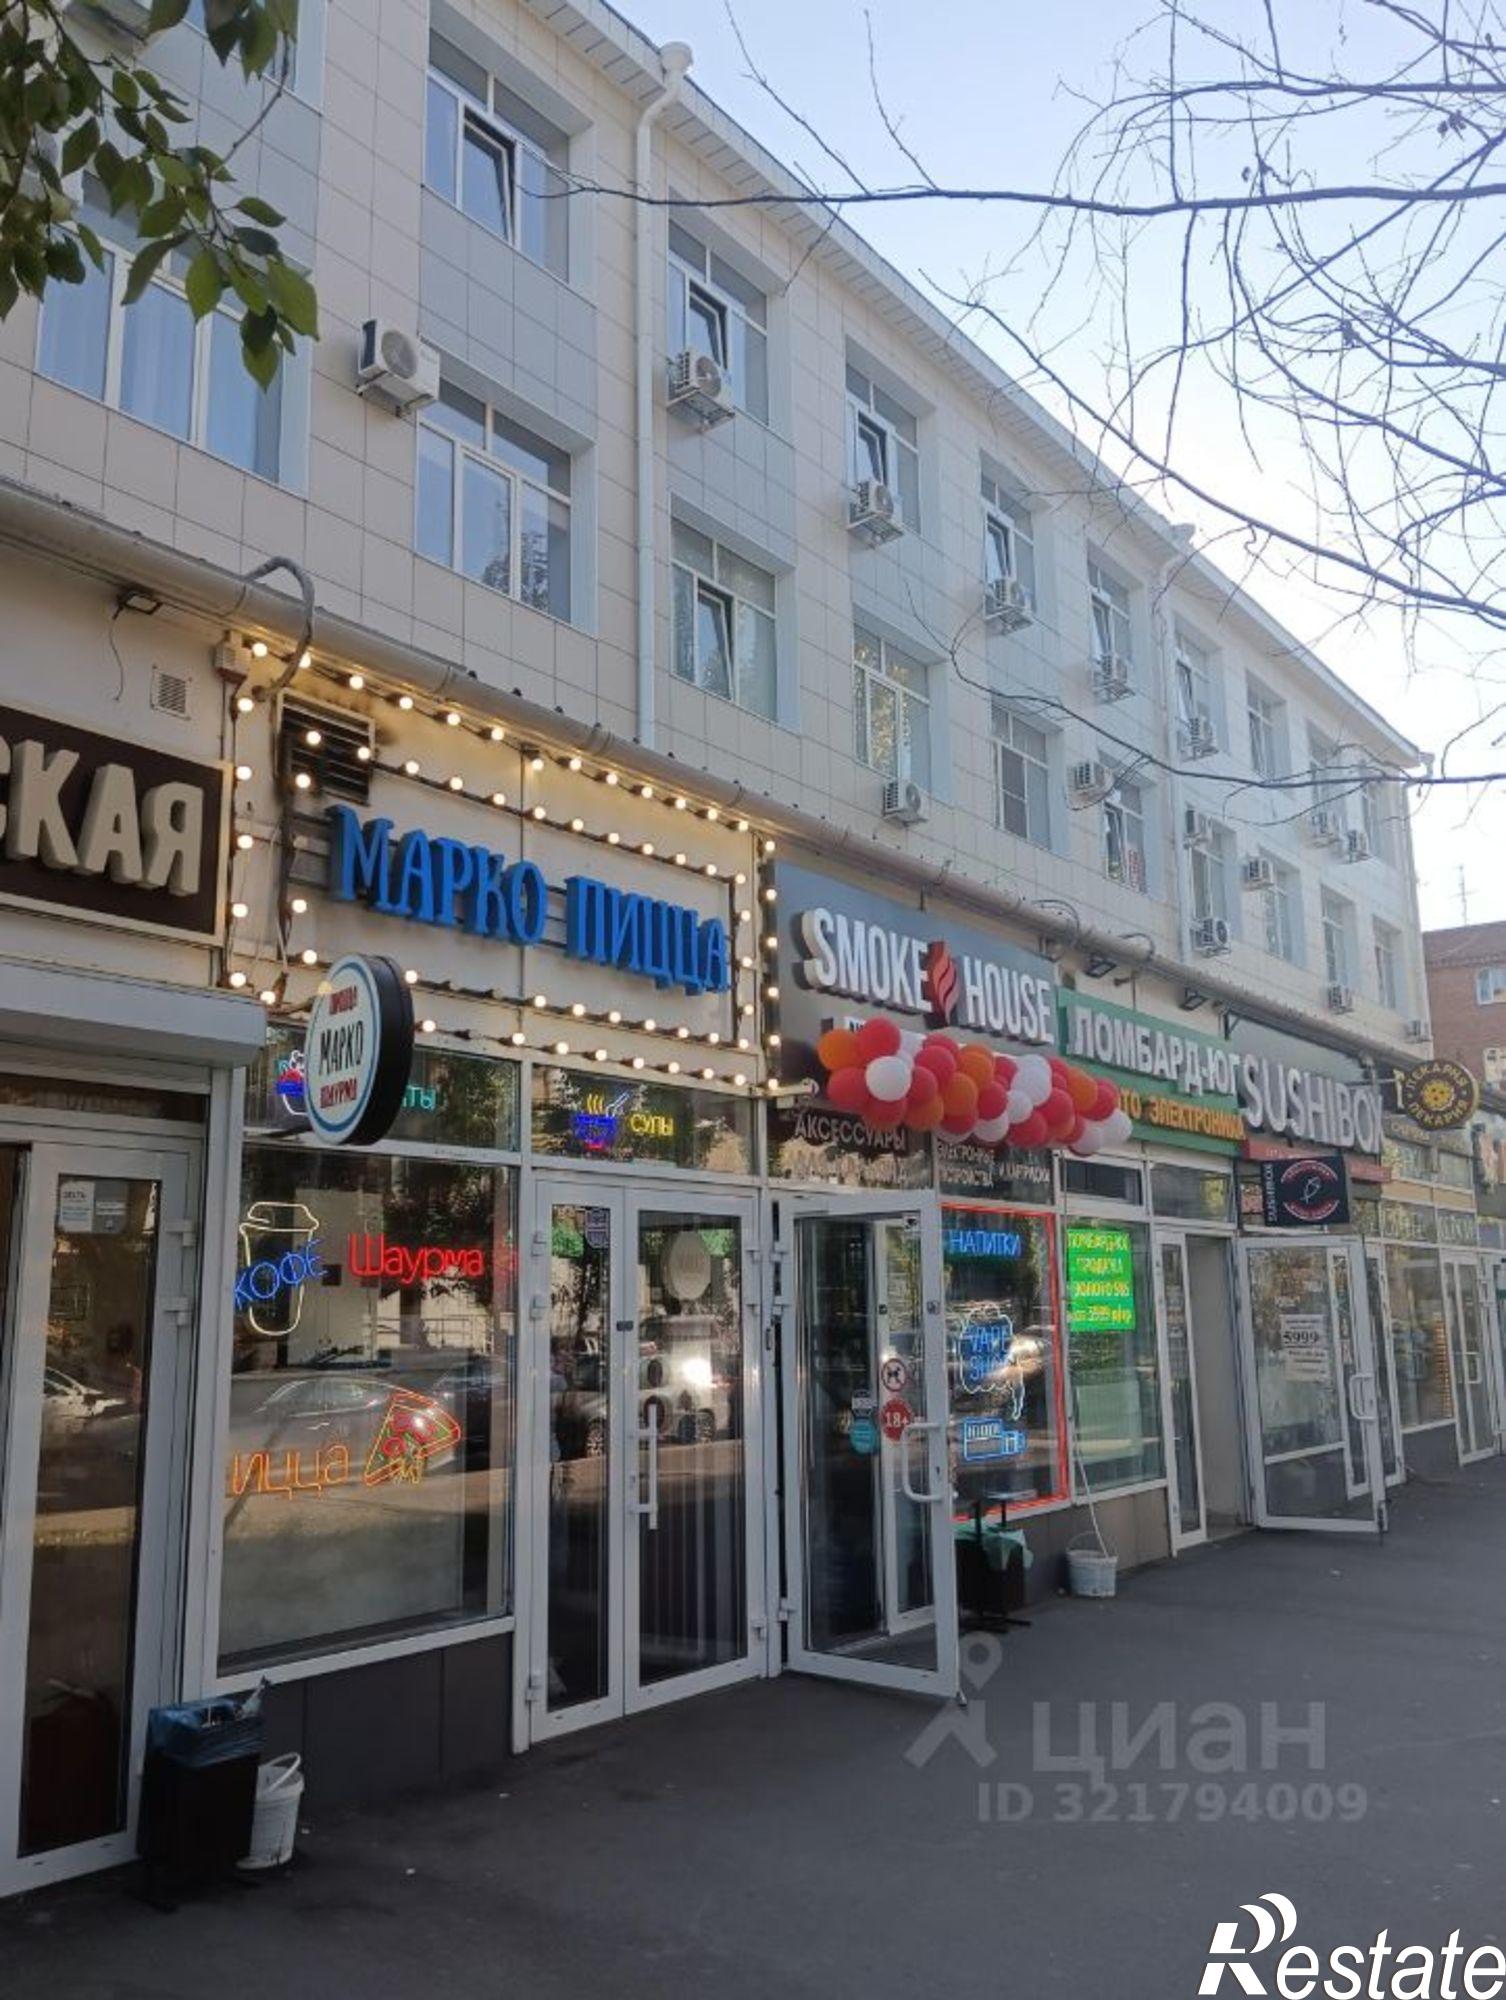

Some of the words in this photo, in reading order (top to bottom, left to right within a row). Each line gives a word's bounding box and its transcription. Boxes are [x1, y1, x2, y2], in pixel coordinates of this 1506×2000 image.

[324, 804, 548, 945] МАРКО
[564, 876, 730, 996] ПИЦЦА
[802, 907, 933, 1014] SMOKE
[963, 955, 1054, 1045] HOUSE
[318, 1020, 364, 1076] МАРКО
[629, 1112, 675, 1137] СУПЫ
[795, 1112, 908, 1151] АКСЕССУАРЫ
[348, 1232, 485, 1285] Шаурма
[948, 1229, 1020, 1256] НАПИТКИ
[233, 1238, 328, 1311] КОФЕ
[885, 1411, 908, 1428] 18+
[232, 1442, 350, 1502] ицца
